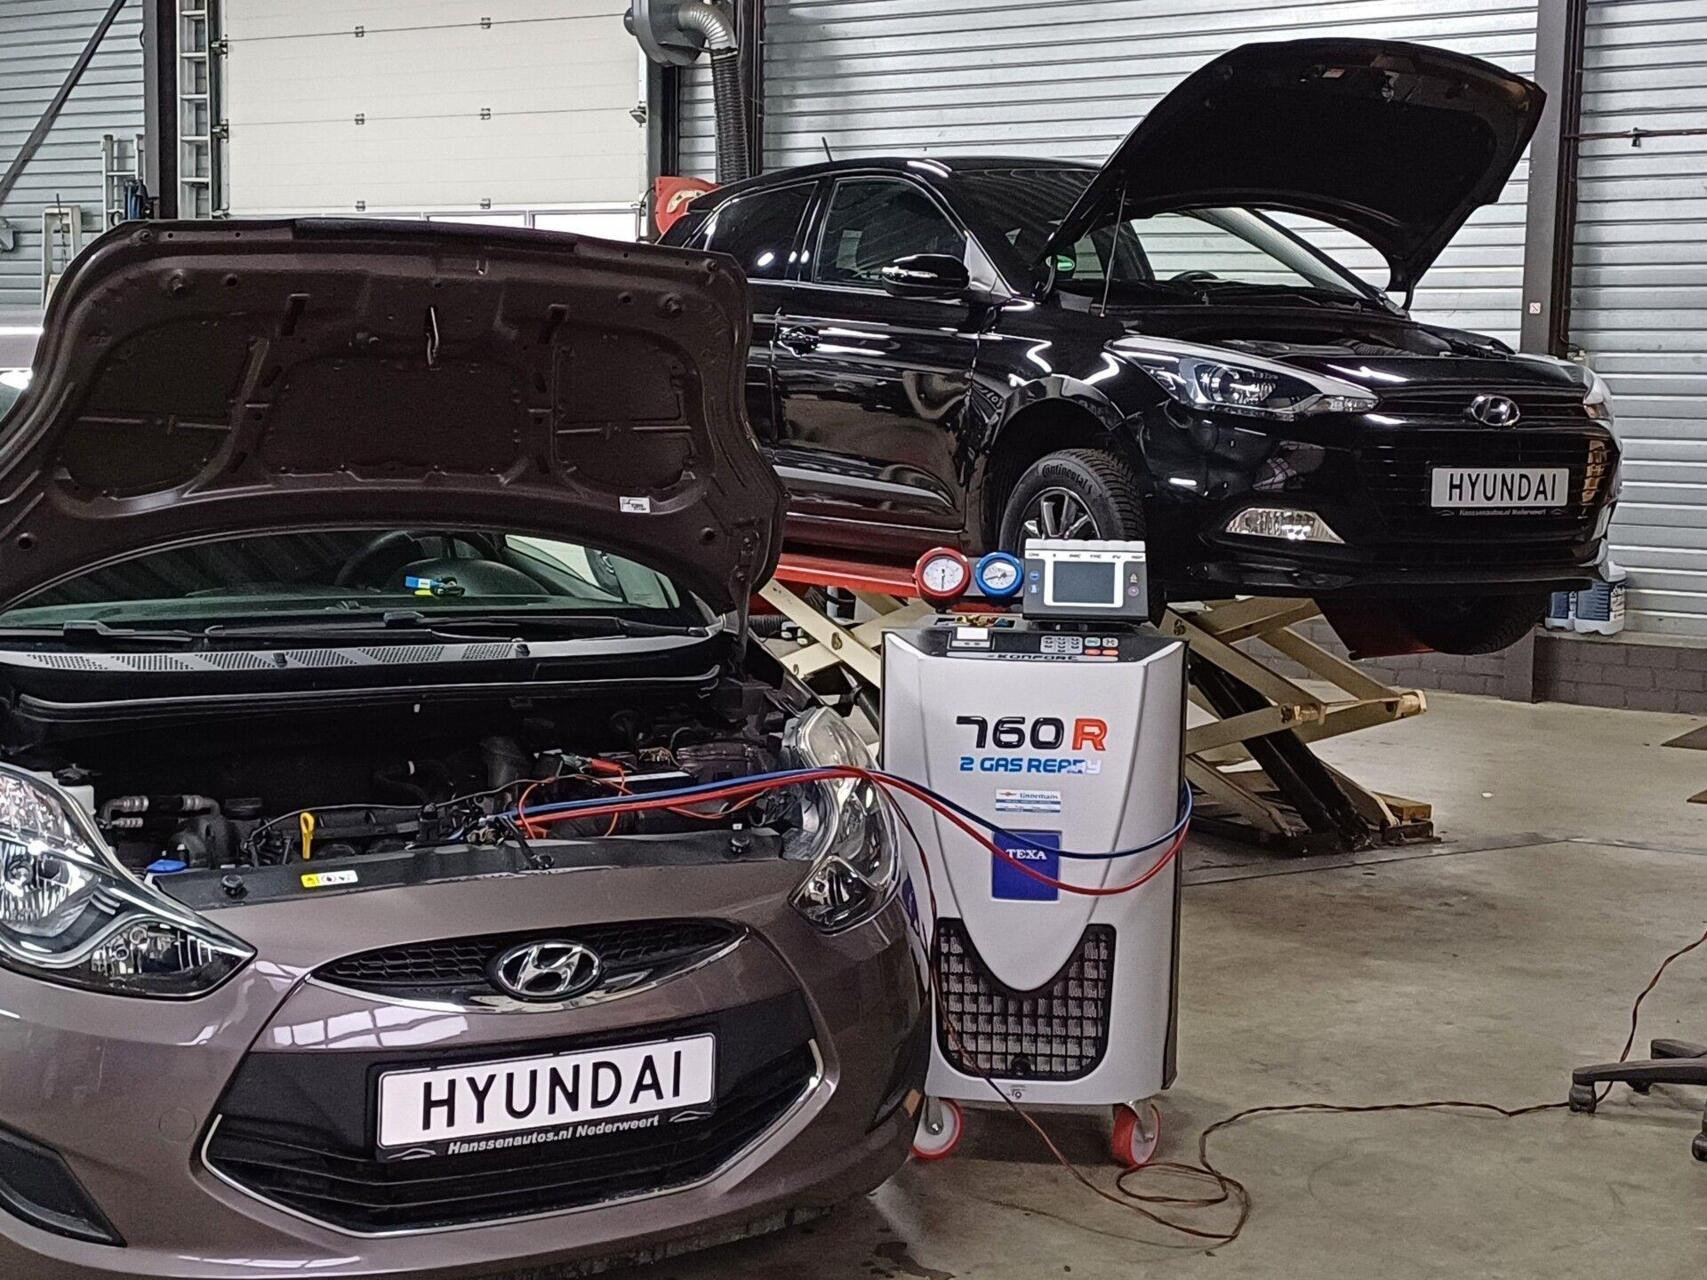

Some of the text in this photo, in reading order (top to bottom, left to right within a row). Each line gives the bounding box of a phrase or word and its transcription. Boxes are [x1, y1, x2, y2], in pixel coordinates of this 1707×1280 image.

[1448, 473, 1557, 501] HYUNDAI
[960, 756, 974, 772] 2
[980, 757, 1023, 773] GAS
[1005, 848, 1048, 860] TEXA
[421, 1050, 682, 1131] HYUNDAI
[447, 1115, 659, 1155] Hanssenautos.nl Nederweert
